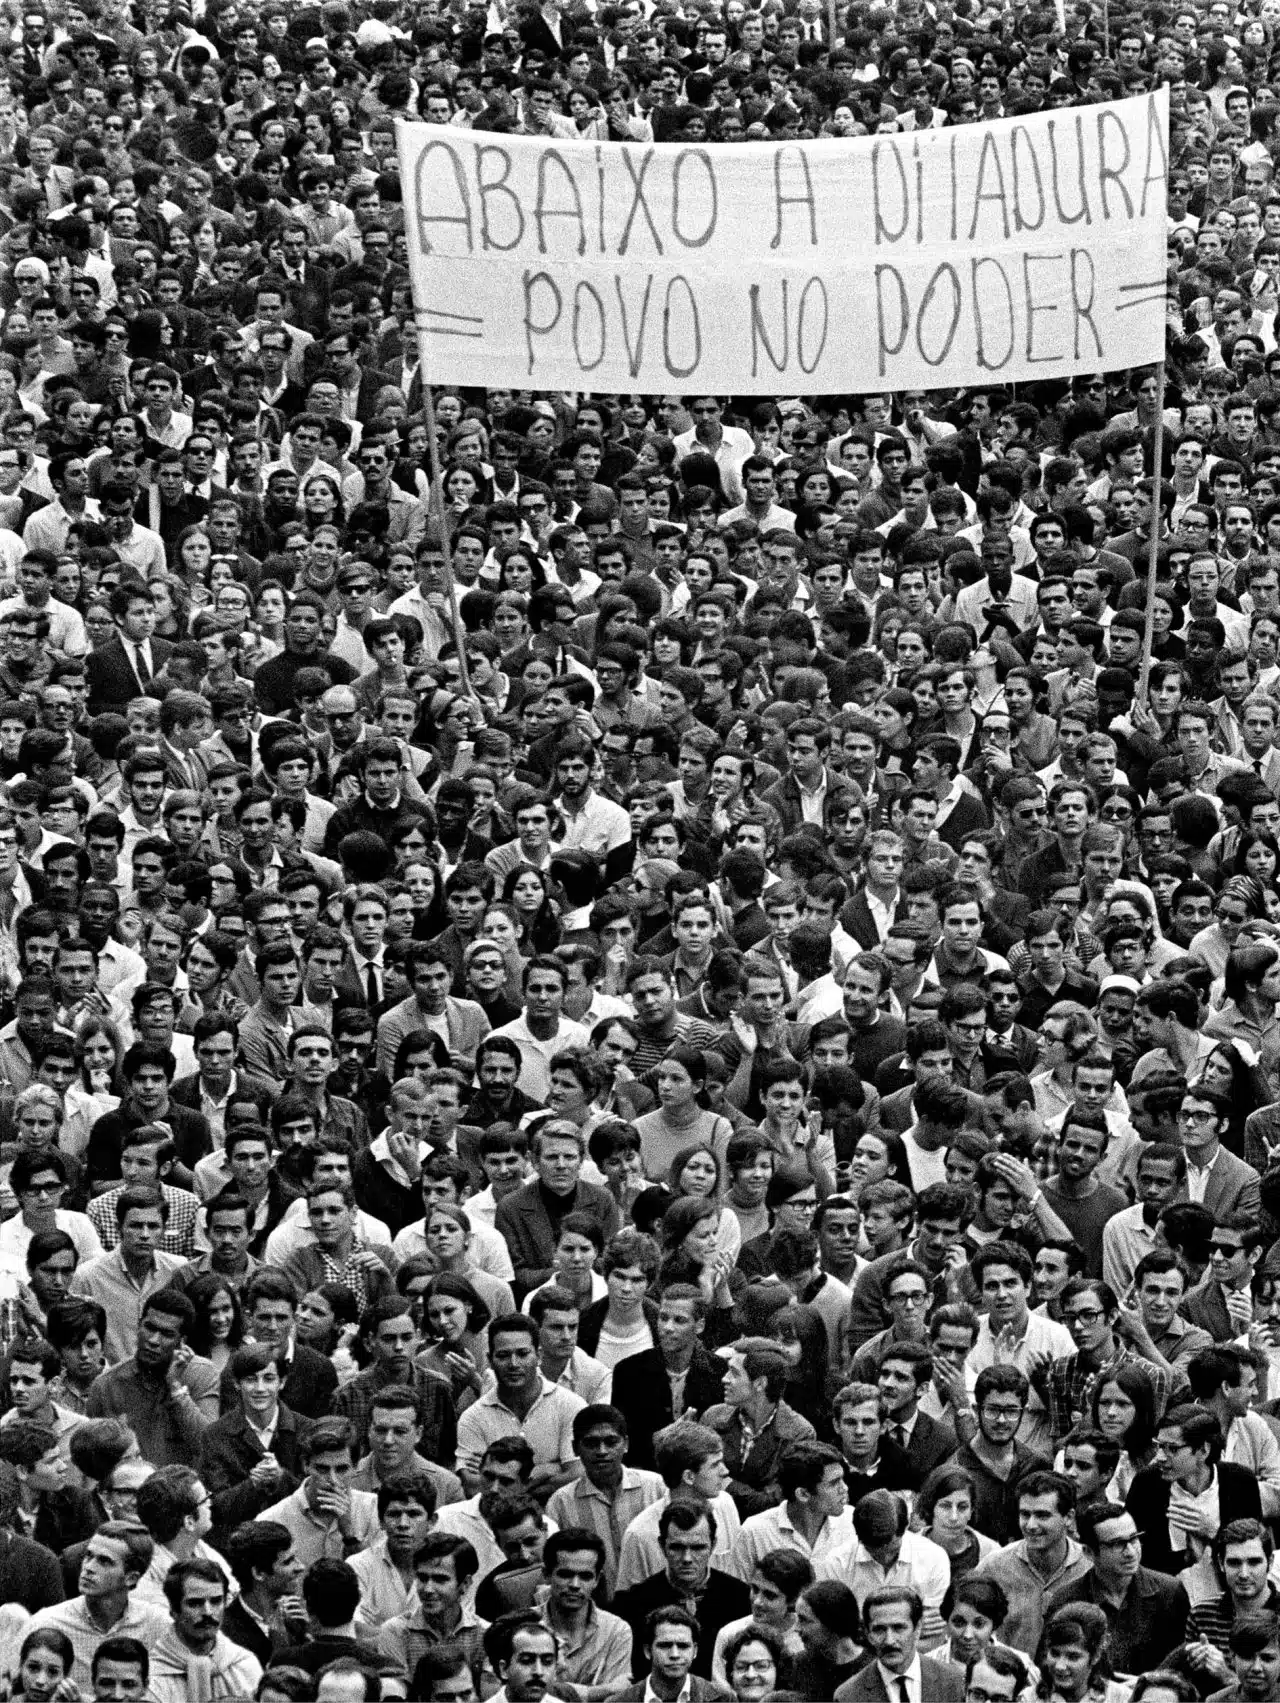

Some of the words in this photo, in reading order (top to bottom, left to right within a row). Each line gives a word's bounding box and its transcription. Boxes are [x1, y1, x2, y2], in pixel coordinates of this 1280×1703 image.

[770, 145, 818, 249] A
[523, 269, 701, 378] POVO
[750, 276, 828, 377] NO
[875, 248, 1102, 377] PODER
